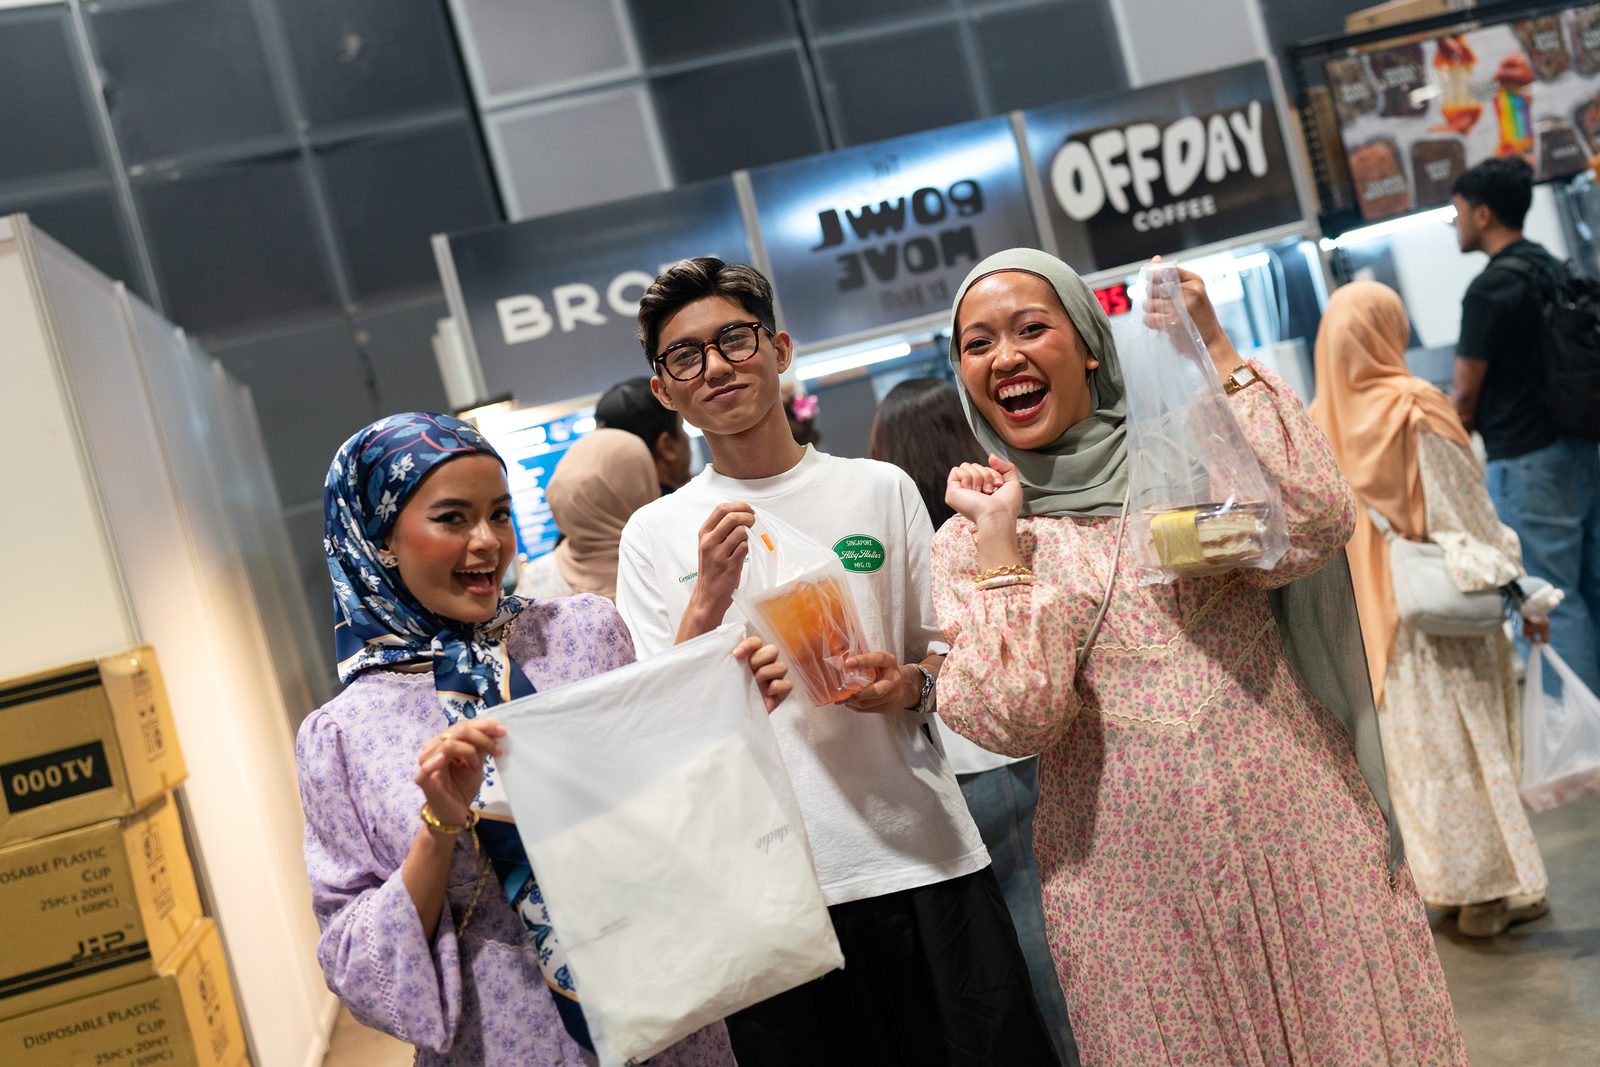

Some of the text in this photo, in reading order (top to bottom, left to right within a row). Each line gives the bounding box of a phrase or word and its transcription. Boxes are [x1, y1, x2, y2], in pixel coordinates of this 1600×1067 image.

[1051, 100, 1268, 221] OFFDAY
[1132, 195, 1217, 232] COFFEE
[678, 571, 699, 584] Genuine
[11, 755, 95, 798] A1000
[52, 847, 107, 870] PLASTIC
[82, 866, 112, 884] CUP
[39, 894, 67, 912] 25PC
[23, 998, 163, 1050] DISPOSABLE PLASTIC
[136, 1018, 166, 1036] CUP
